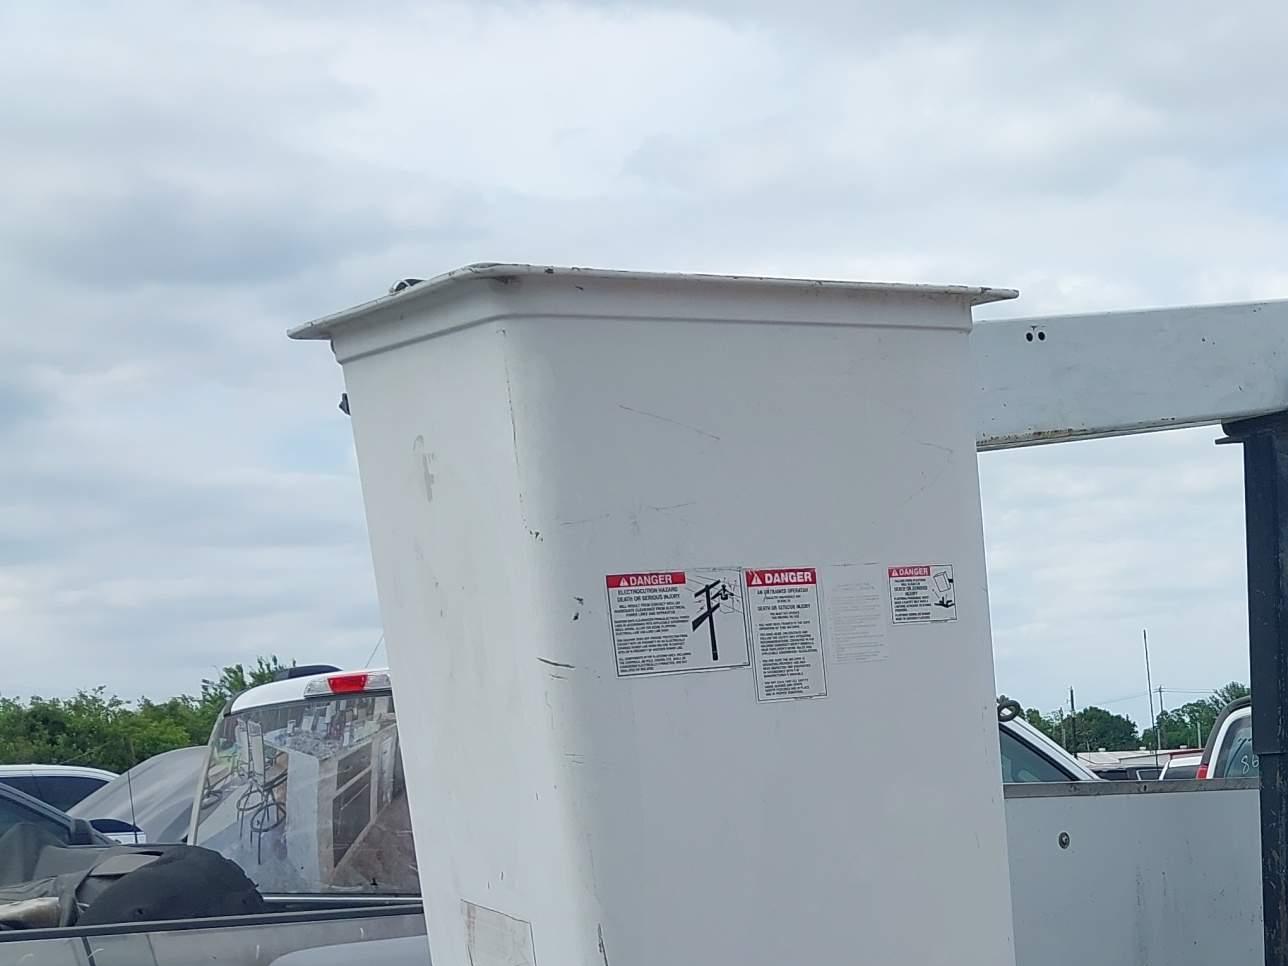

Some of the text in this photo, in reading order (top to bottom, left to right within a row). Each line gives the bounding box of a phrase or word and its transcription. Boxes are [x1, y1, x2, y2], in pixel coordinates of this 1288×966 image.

[764, 571, 812, 584] DANGER
[900, 568, 928, 576] DANGER
[629, 574, 672, 586] DANGER
